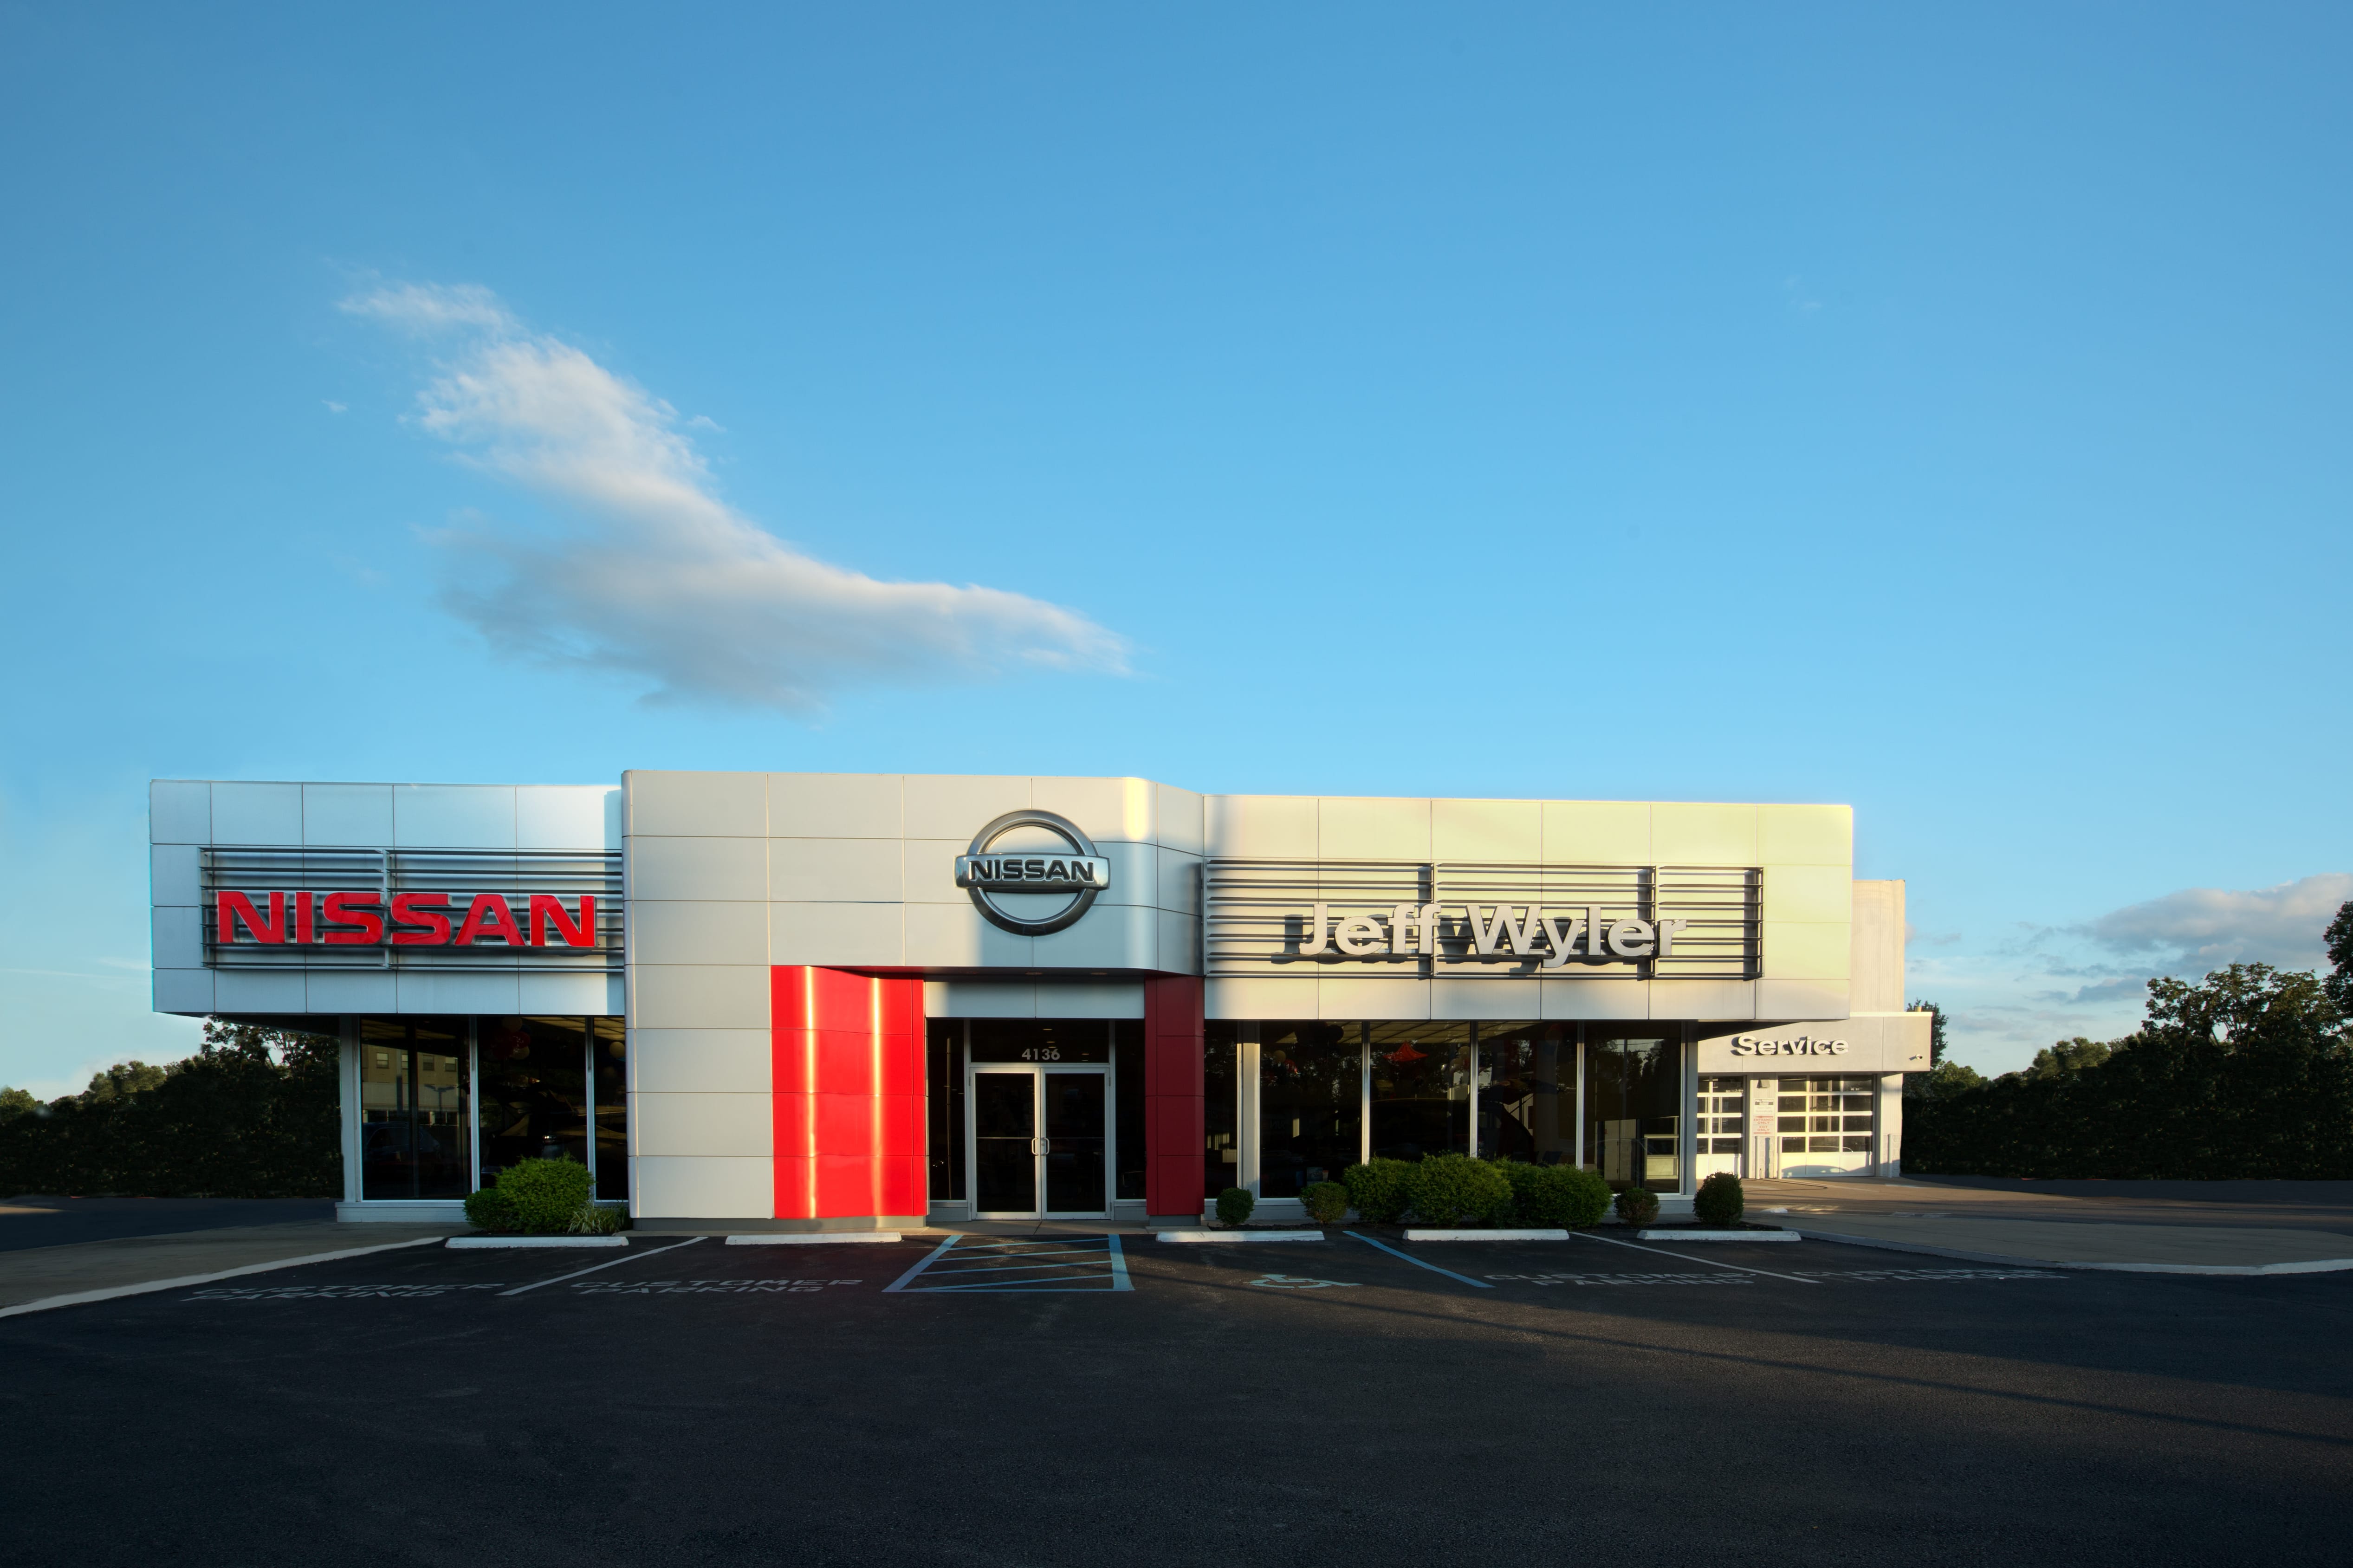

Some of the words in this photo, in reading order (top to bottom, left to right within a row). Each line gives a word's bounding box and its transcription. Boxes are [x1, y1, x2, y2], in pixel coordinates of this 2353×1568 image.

[969, 859, 1095, 881] NISSAN
[217, 891, 596, 947] NISSAN
[1299, 903, 1442, 955] Jeff
[1465, 905, 1687, 968] Wyler
[1737, 1035, 1850, 1055] Service
[1022, 1049, 1060, 1060] 4136
[193, 1283, 506, 1294] CUSTOMER
[570, 1279, 863, 1288] CUSTOMER
[180, 1290, 446, 1302] PARKING
